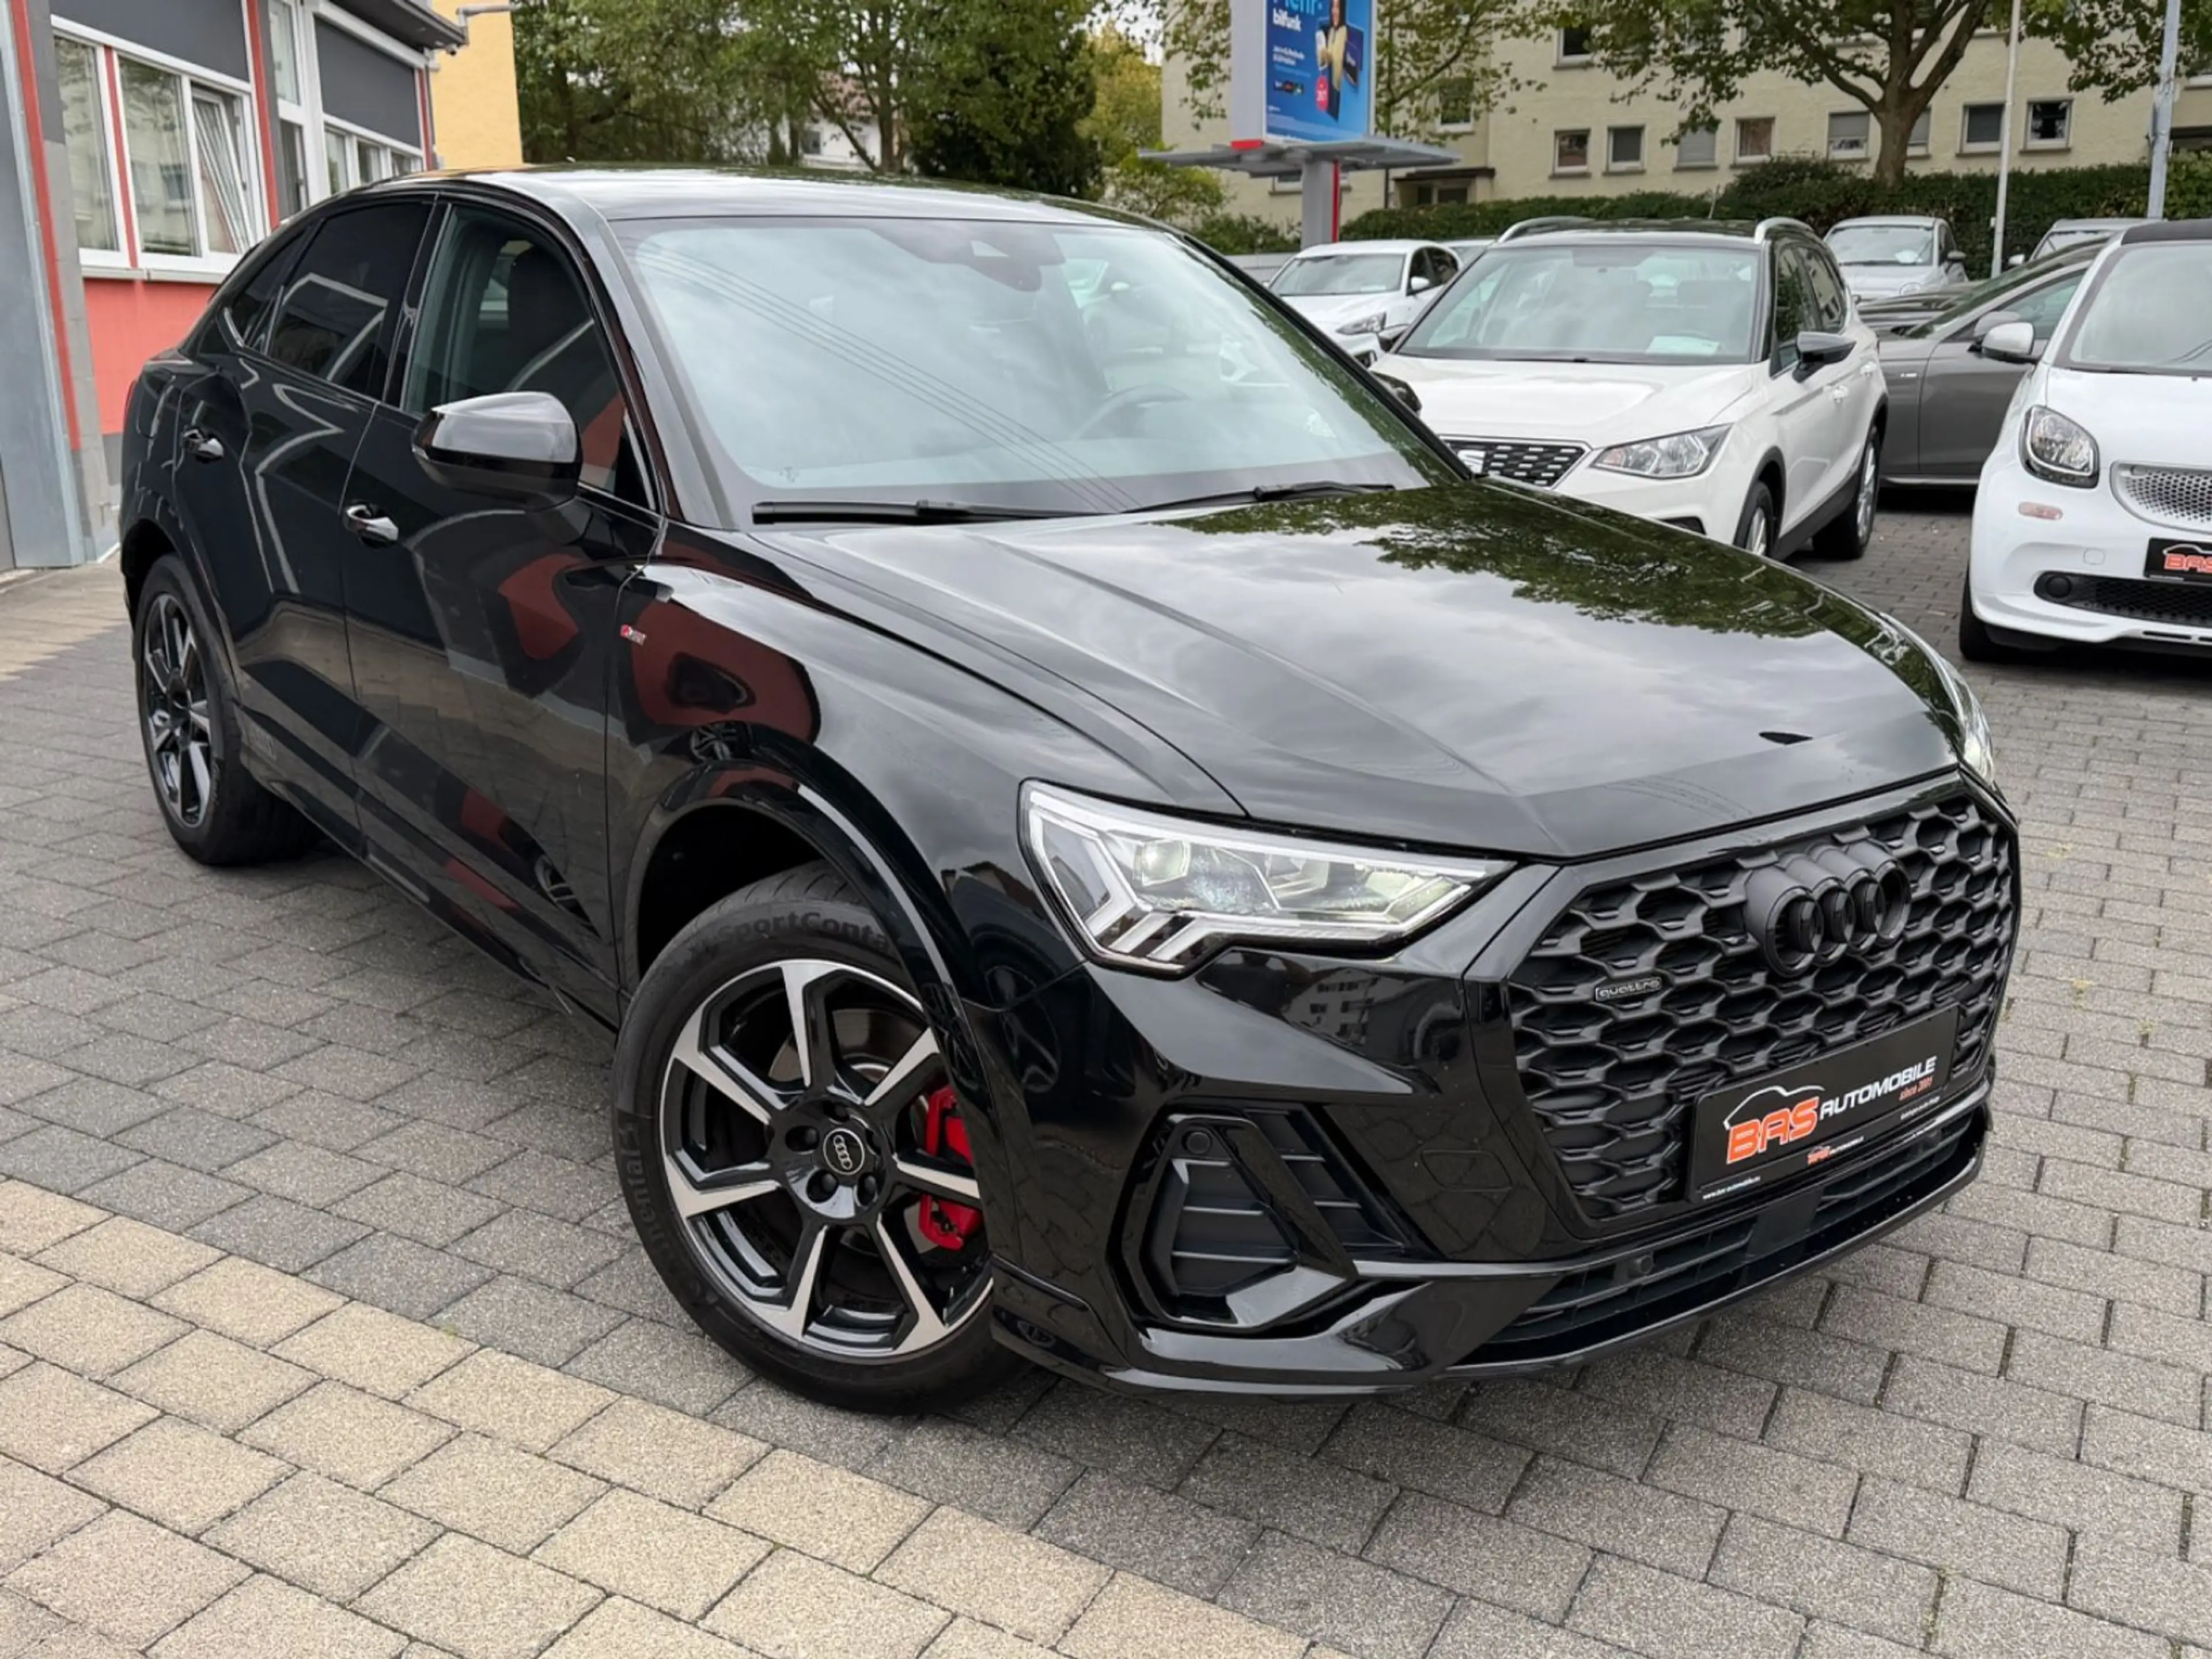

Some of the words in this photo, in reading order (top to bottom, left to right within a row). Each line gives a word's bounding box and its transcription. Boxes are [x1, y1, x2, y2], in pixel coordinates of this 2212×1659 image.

[1600, 979, 1661, 998] quattro
[1726, 1096, 1820, 1164] BAS
[1819, 1055, 1937, 1120] AUTOMOBILE
